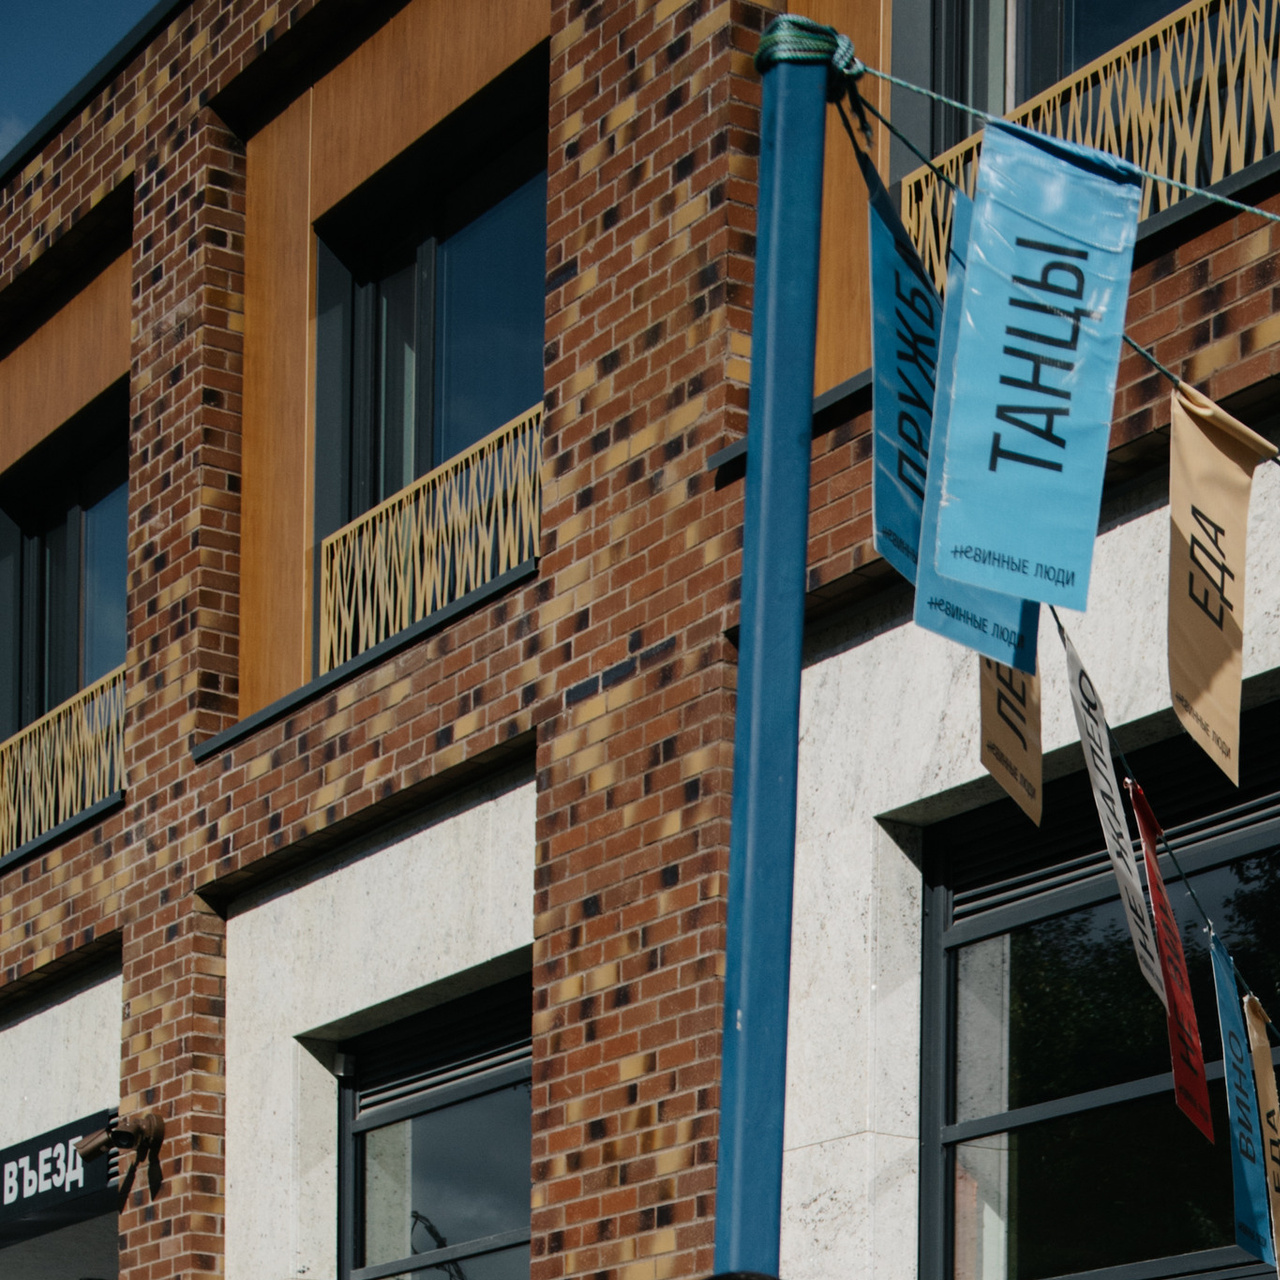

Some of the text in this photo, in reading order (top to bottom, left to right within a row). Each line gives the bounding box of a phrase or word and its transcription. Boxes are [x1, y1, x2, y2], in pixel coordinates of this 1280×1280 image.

[988, 237, 1102, 473] ТАНЦЫ
[1033, 563, 1076, 588] ЛЮДИ
[1188, 504, 1235, 631] ЕДА
[1229, 1029, 1257, 1164] ВИНО
[3, 1135, 84, 1206] ВЪЕЗД
